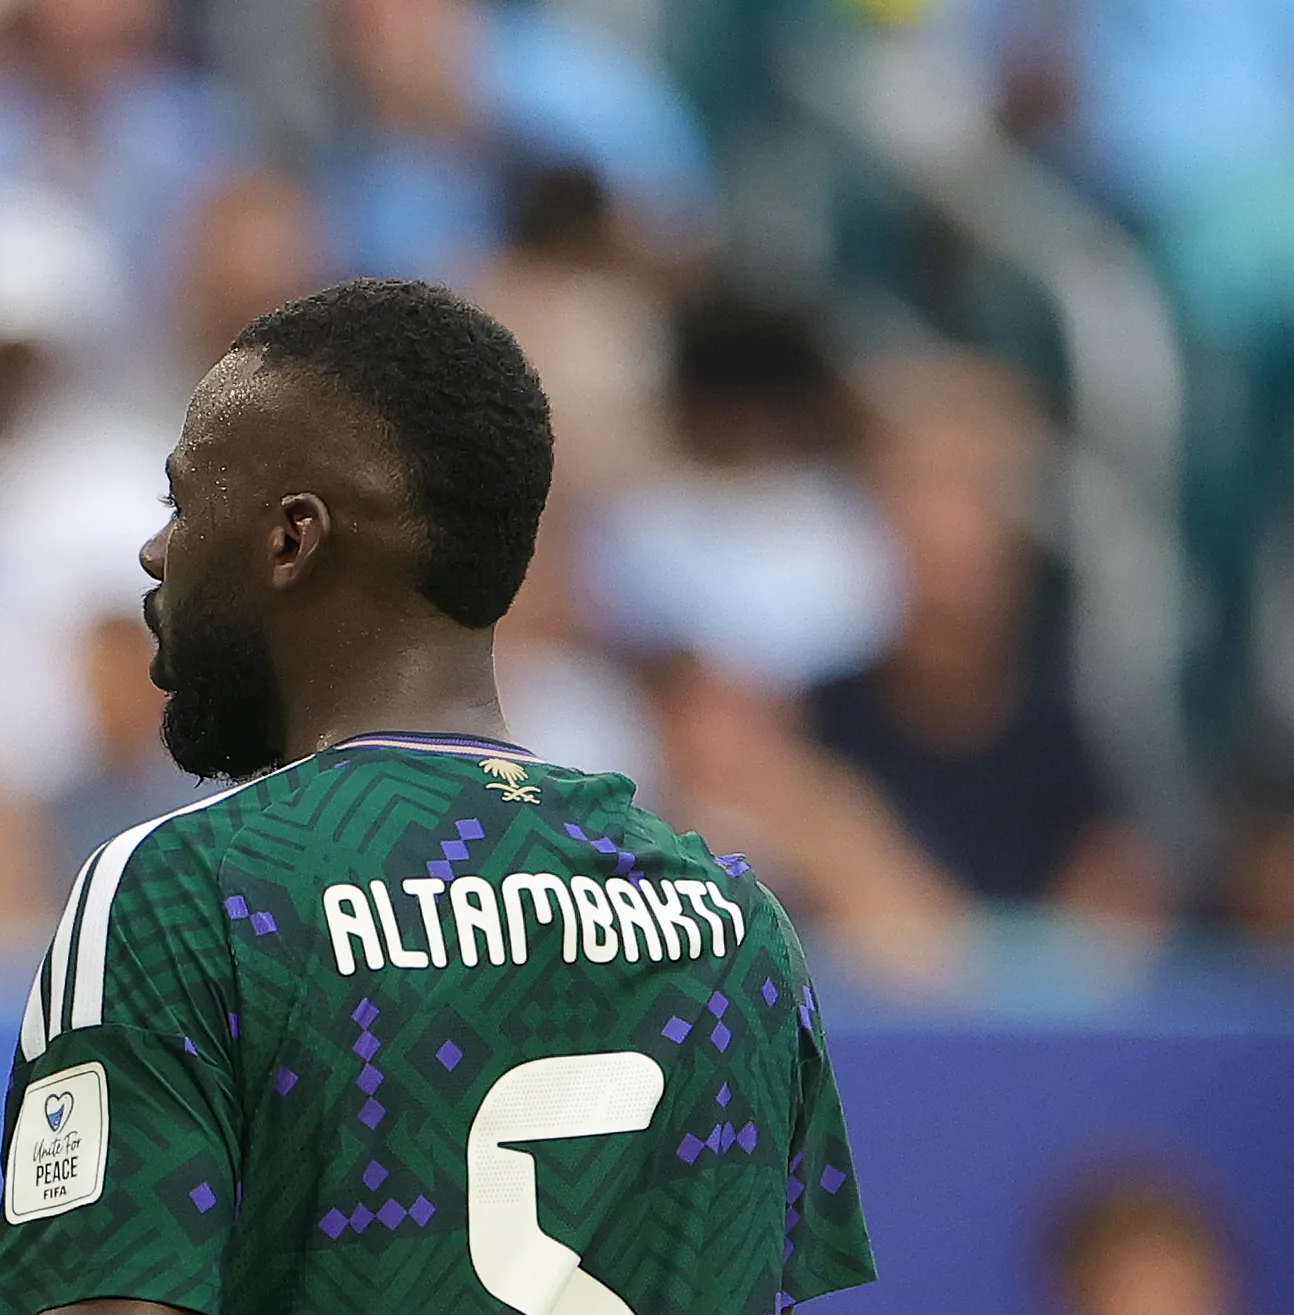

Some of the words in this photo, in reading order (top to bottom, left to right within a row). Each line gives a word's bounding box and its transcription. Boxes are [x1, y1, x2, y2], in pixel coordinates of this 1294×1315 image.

[323, 873, 745, 977] ALTAMBAKTI
[33, 1137, 63, 1163] Unite
[64, 1131, 83, 1155] For
[36, 1156, 78, 1187] PEACE
[43, 1186, 67, 1200] FIFA
